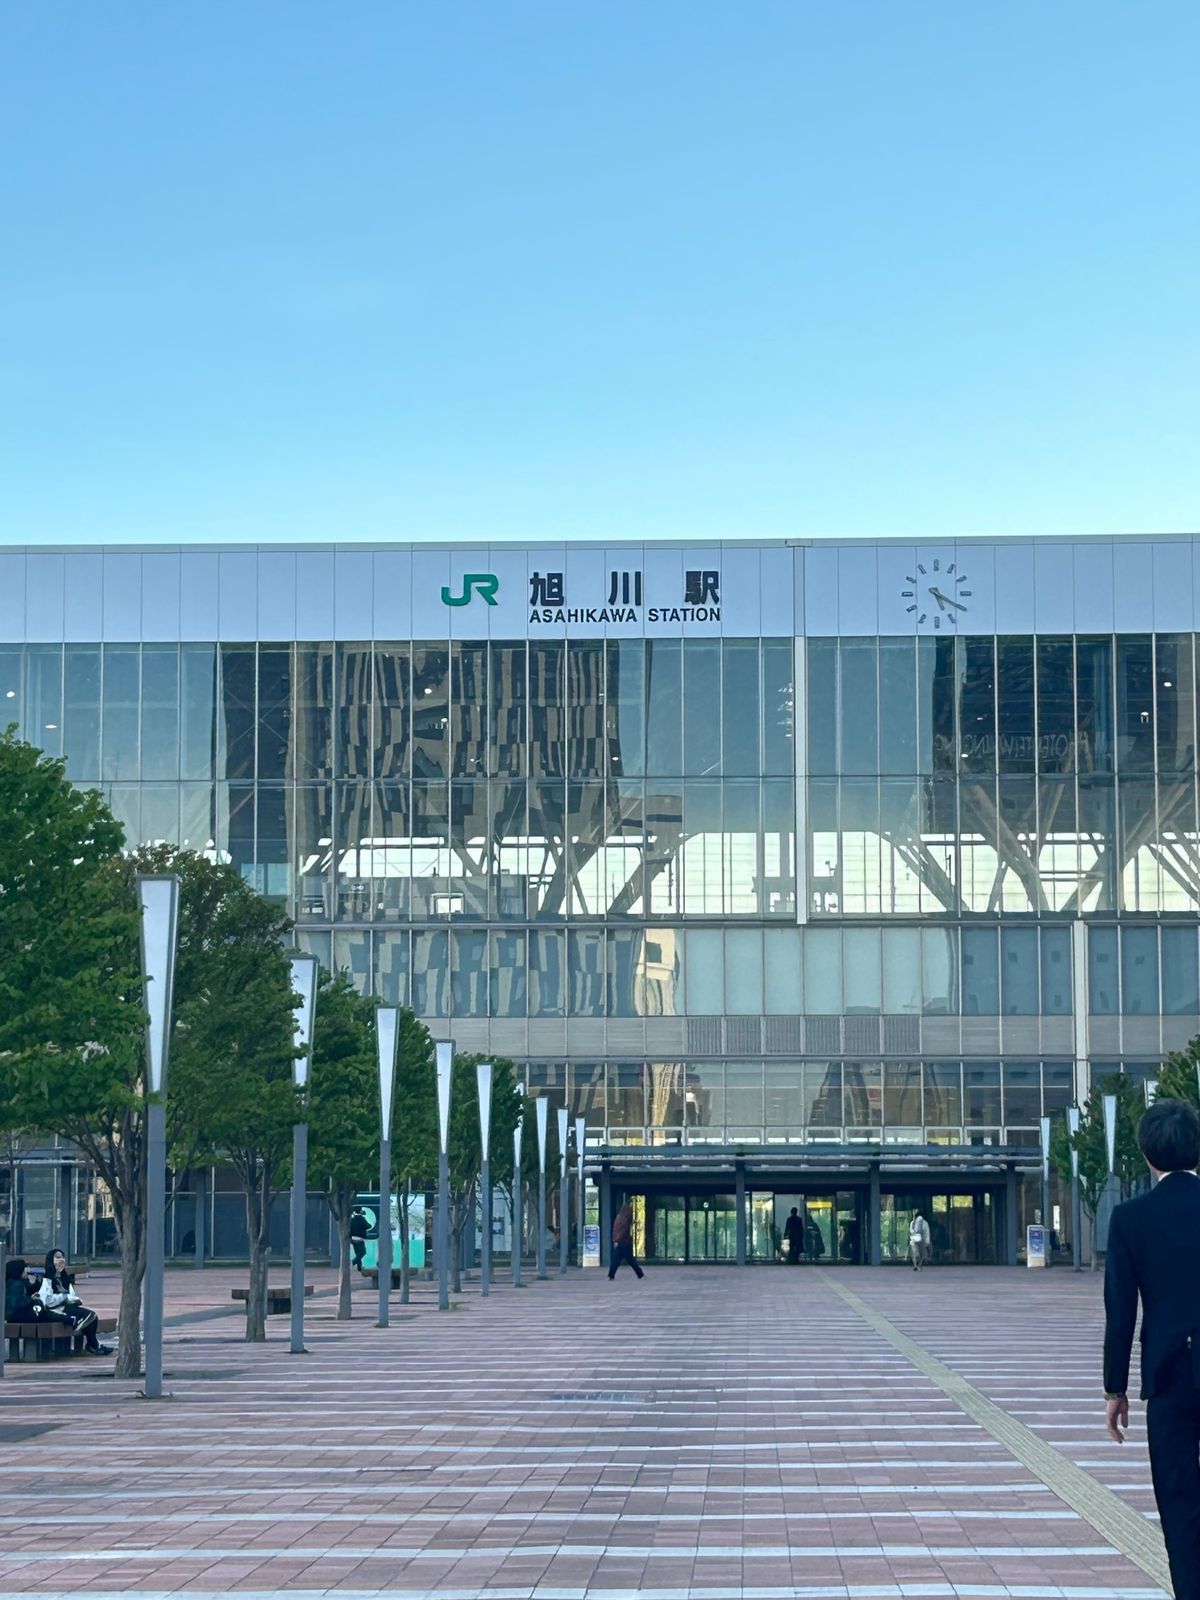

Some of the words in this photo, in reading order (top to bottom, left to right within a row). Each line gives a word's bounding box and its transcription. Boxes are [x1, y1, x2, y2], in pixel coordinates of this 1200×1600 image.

[441, 573, 499, 607] JR
[529, 569, 720, 607] 旭川駅
[529, 608, 638, 624] ASAHIKAWA
[648, 607, 721, 623] STATION
